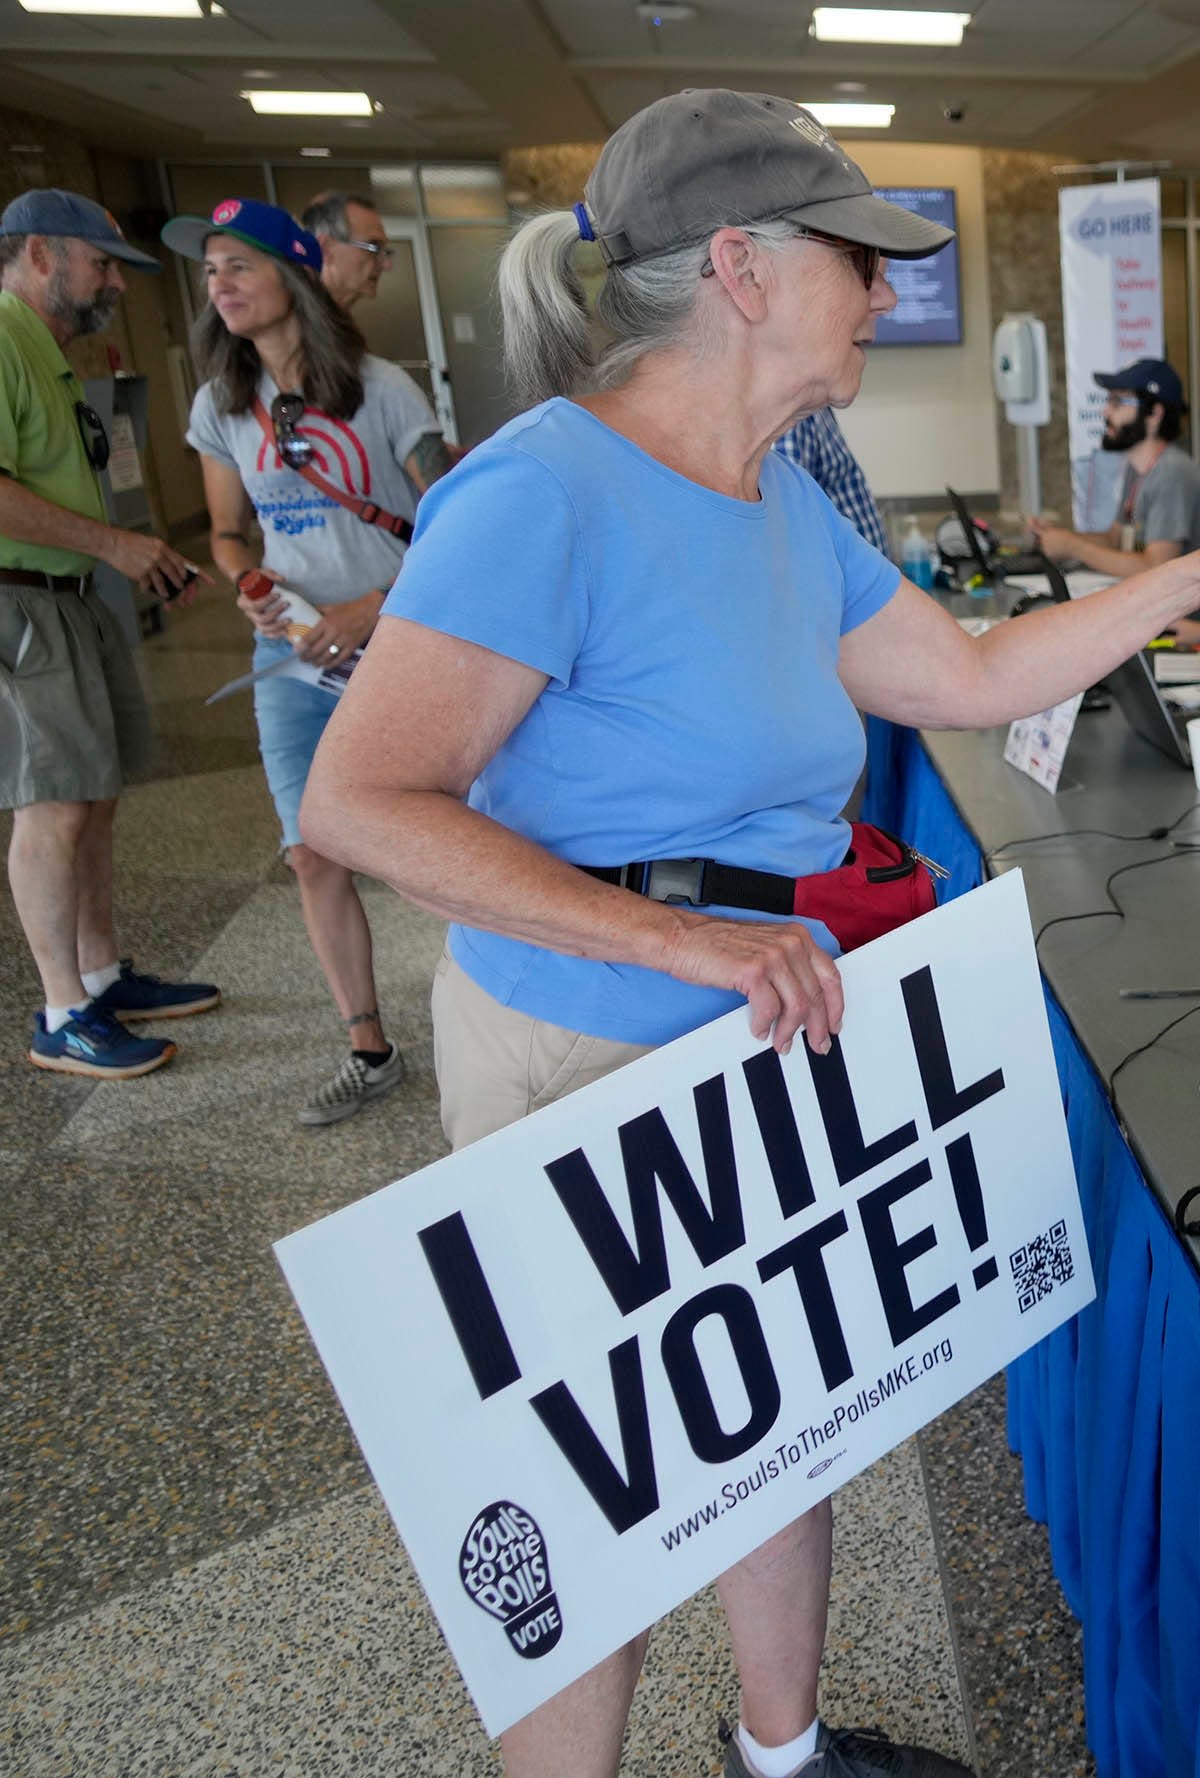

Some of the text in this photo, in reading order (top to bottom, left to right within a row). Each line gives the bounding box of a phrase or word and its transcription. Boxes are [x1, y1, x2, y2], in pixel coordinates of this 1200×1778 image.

[1079, 212, 1153, 240] GO HERE
[418, 1211, 522, 1400] I
[544, 964, 1005, 1316] WILL
[529, 1133, 999, 1535] VOTE!
[660, 1337, 954, 1552] www.SoulsToThePollsMKE.org
[463, 1507, 535, 1570] Souls
[465, 1533, 542, 1592] to the
[511, 1606, 560, 1650] VOTE
